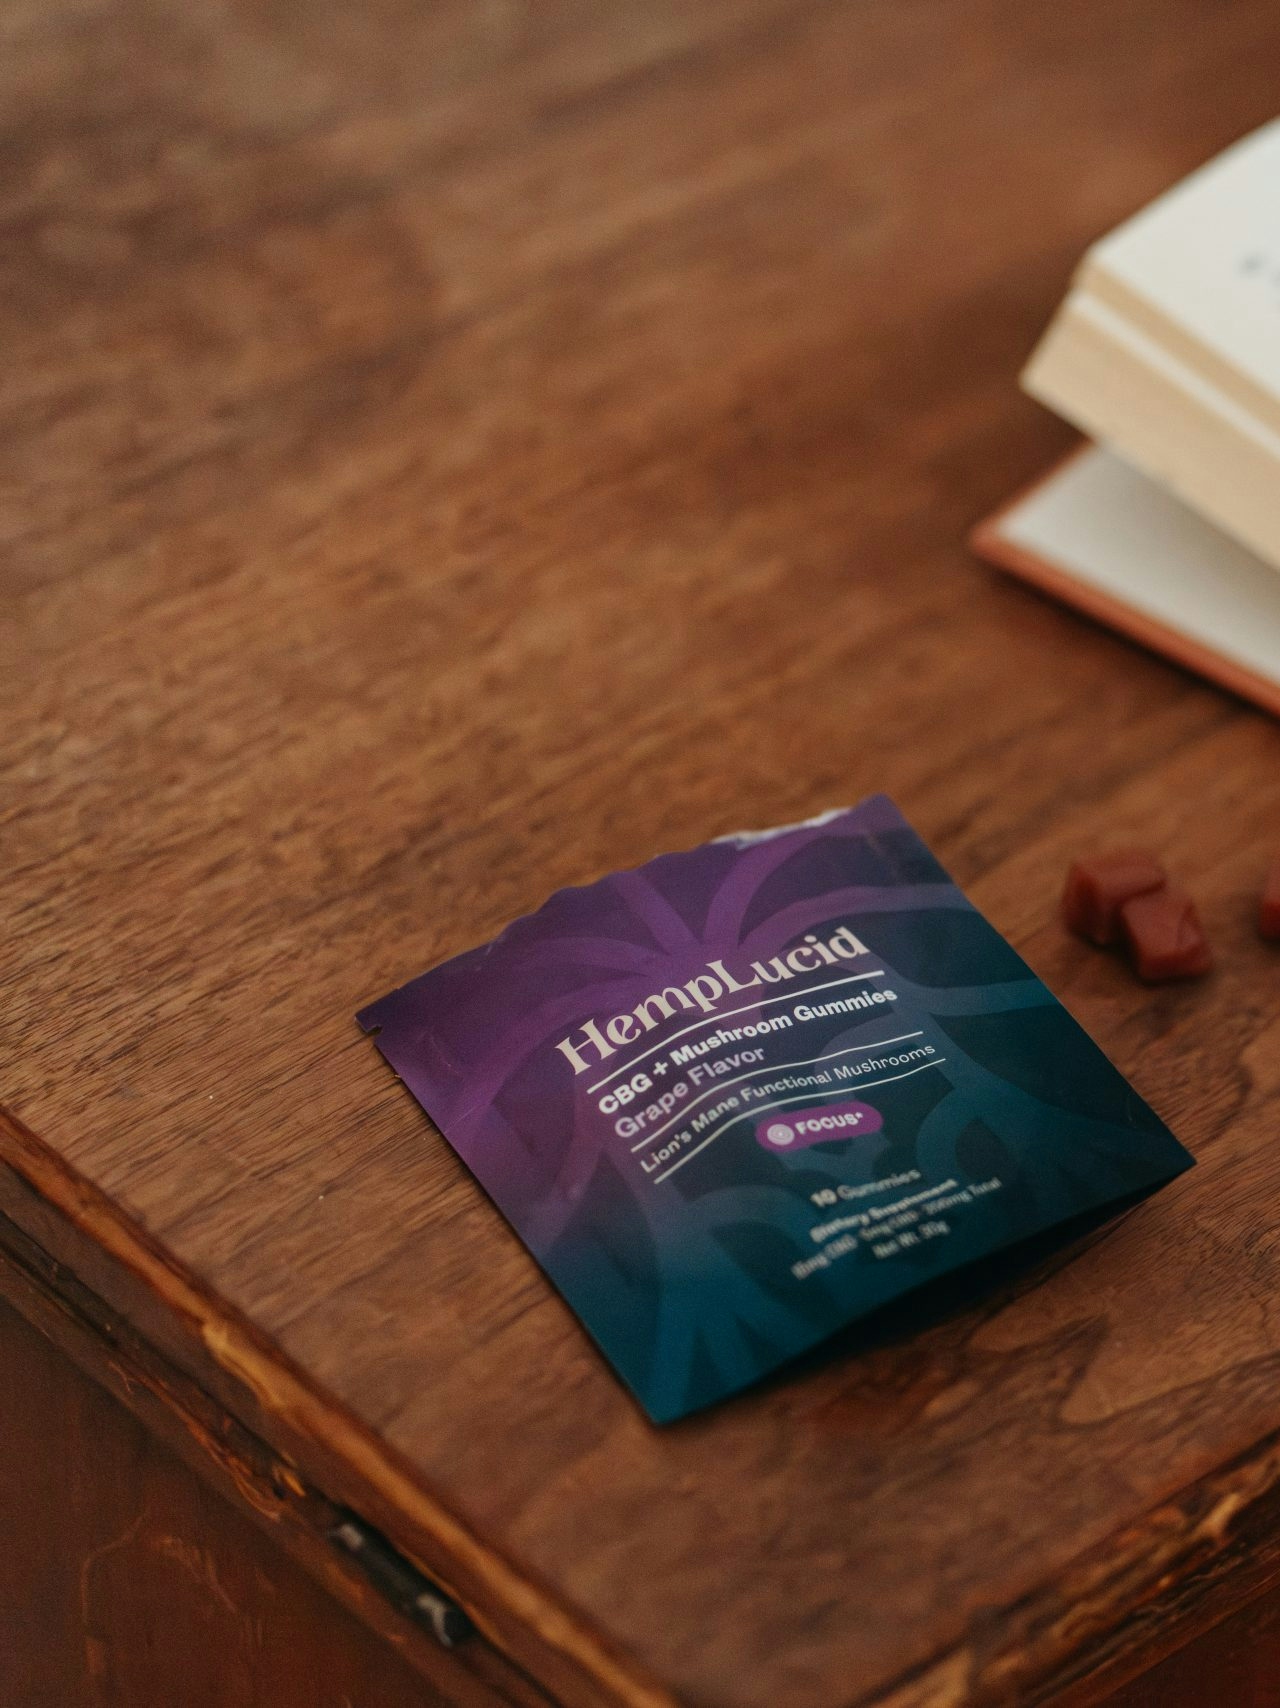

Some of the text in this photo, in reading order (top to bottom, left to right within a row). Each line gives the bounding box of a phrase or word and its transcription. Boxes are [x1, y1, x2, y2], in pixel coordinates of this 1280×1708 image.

[555, 926, 870, 1075] HempLucid
[598, 989, 898, 1114] CBG + Mushroom Gummies
[614, 1047, 765, 1138] Grape Flavor
[640, 1130, 692, 1173] Lion's
[740, 1070, 832, 1101] Functional
[833, 1045, 935, 1080] Mushrooms
